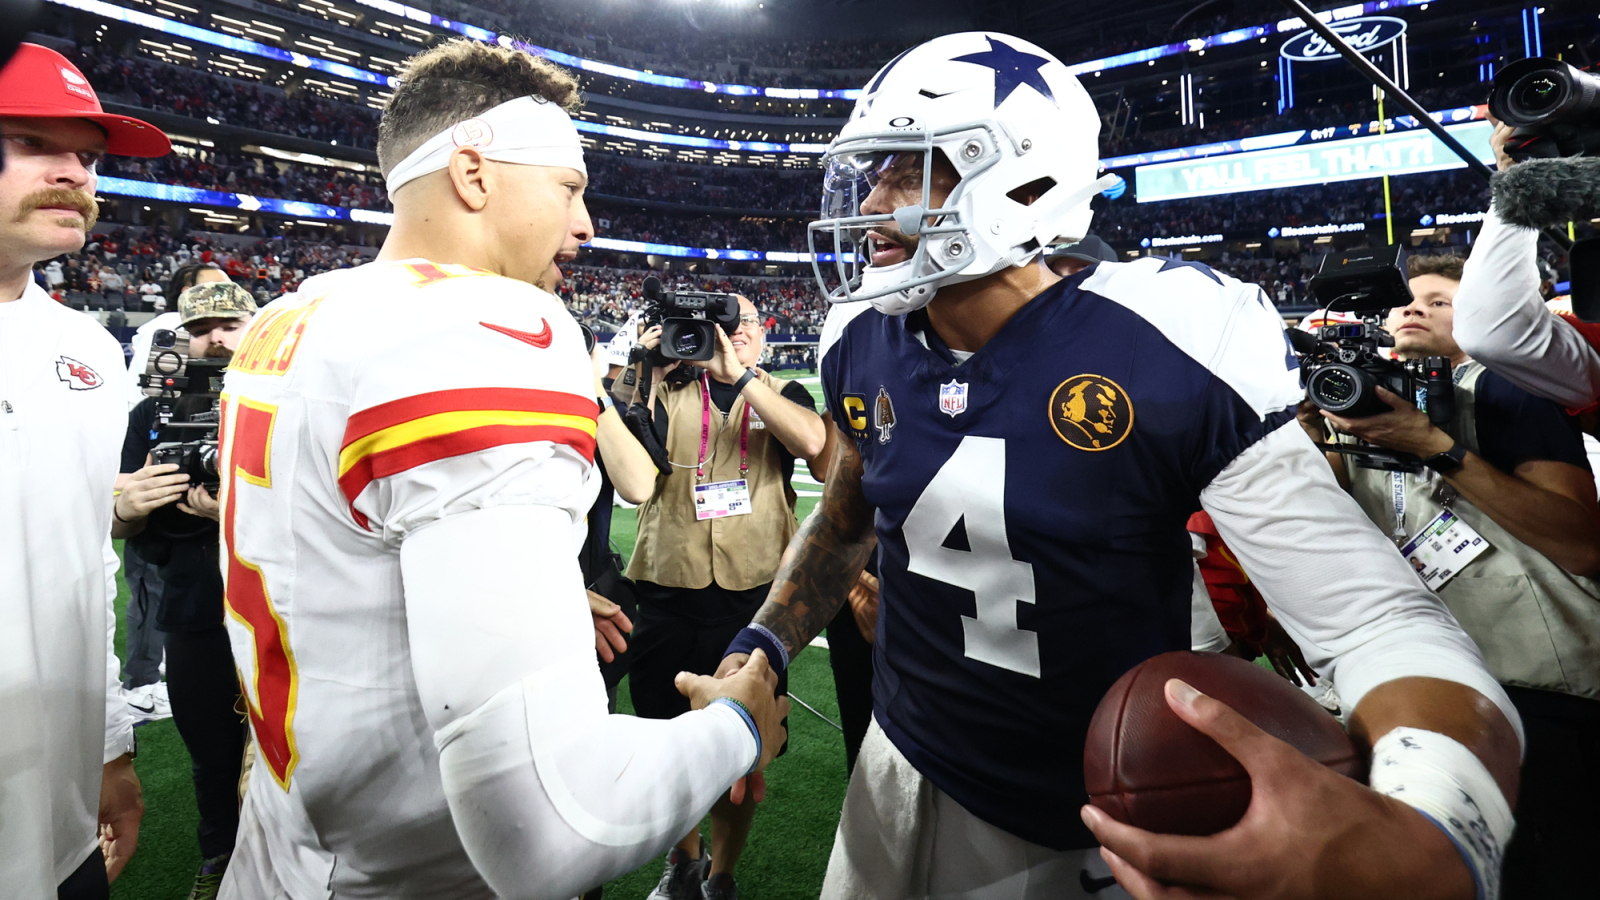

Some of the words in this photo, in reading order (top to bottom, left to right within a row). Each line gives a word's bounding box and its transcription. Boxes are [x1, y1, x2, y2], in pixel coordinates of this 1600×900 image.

[1254, 152, 1320, 183] FEEL
[1321, 136, 1434, 175] THAT?!
[1281, 221, 1365, 237] Blockchain.com
[943, 396, 962, 410] NFL
[749, 421, 766, 430] MED
[1394, 484, 1404, 514] STADIUM
[901, 435, 1041, 679] 4
[218, 392, 300, 794] 5
